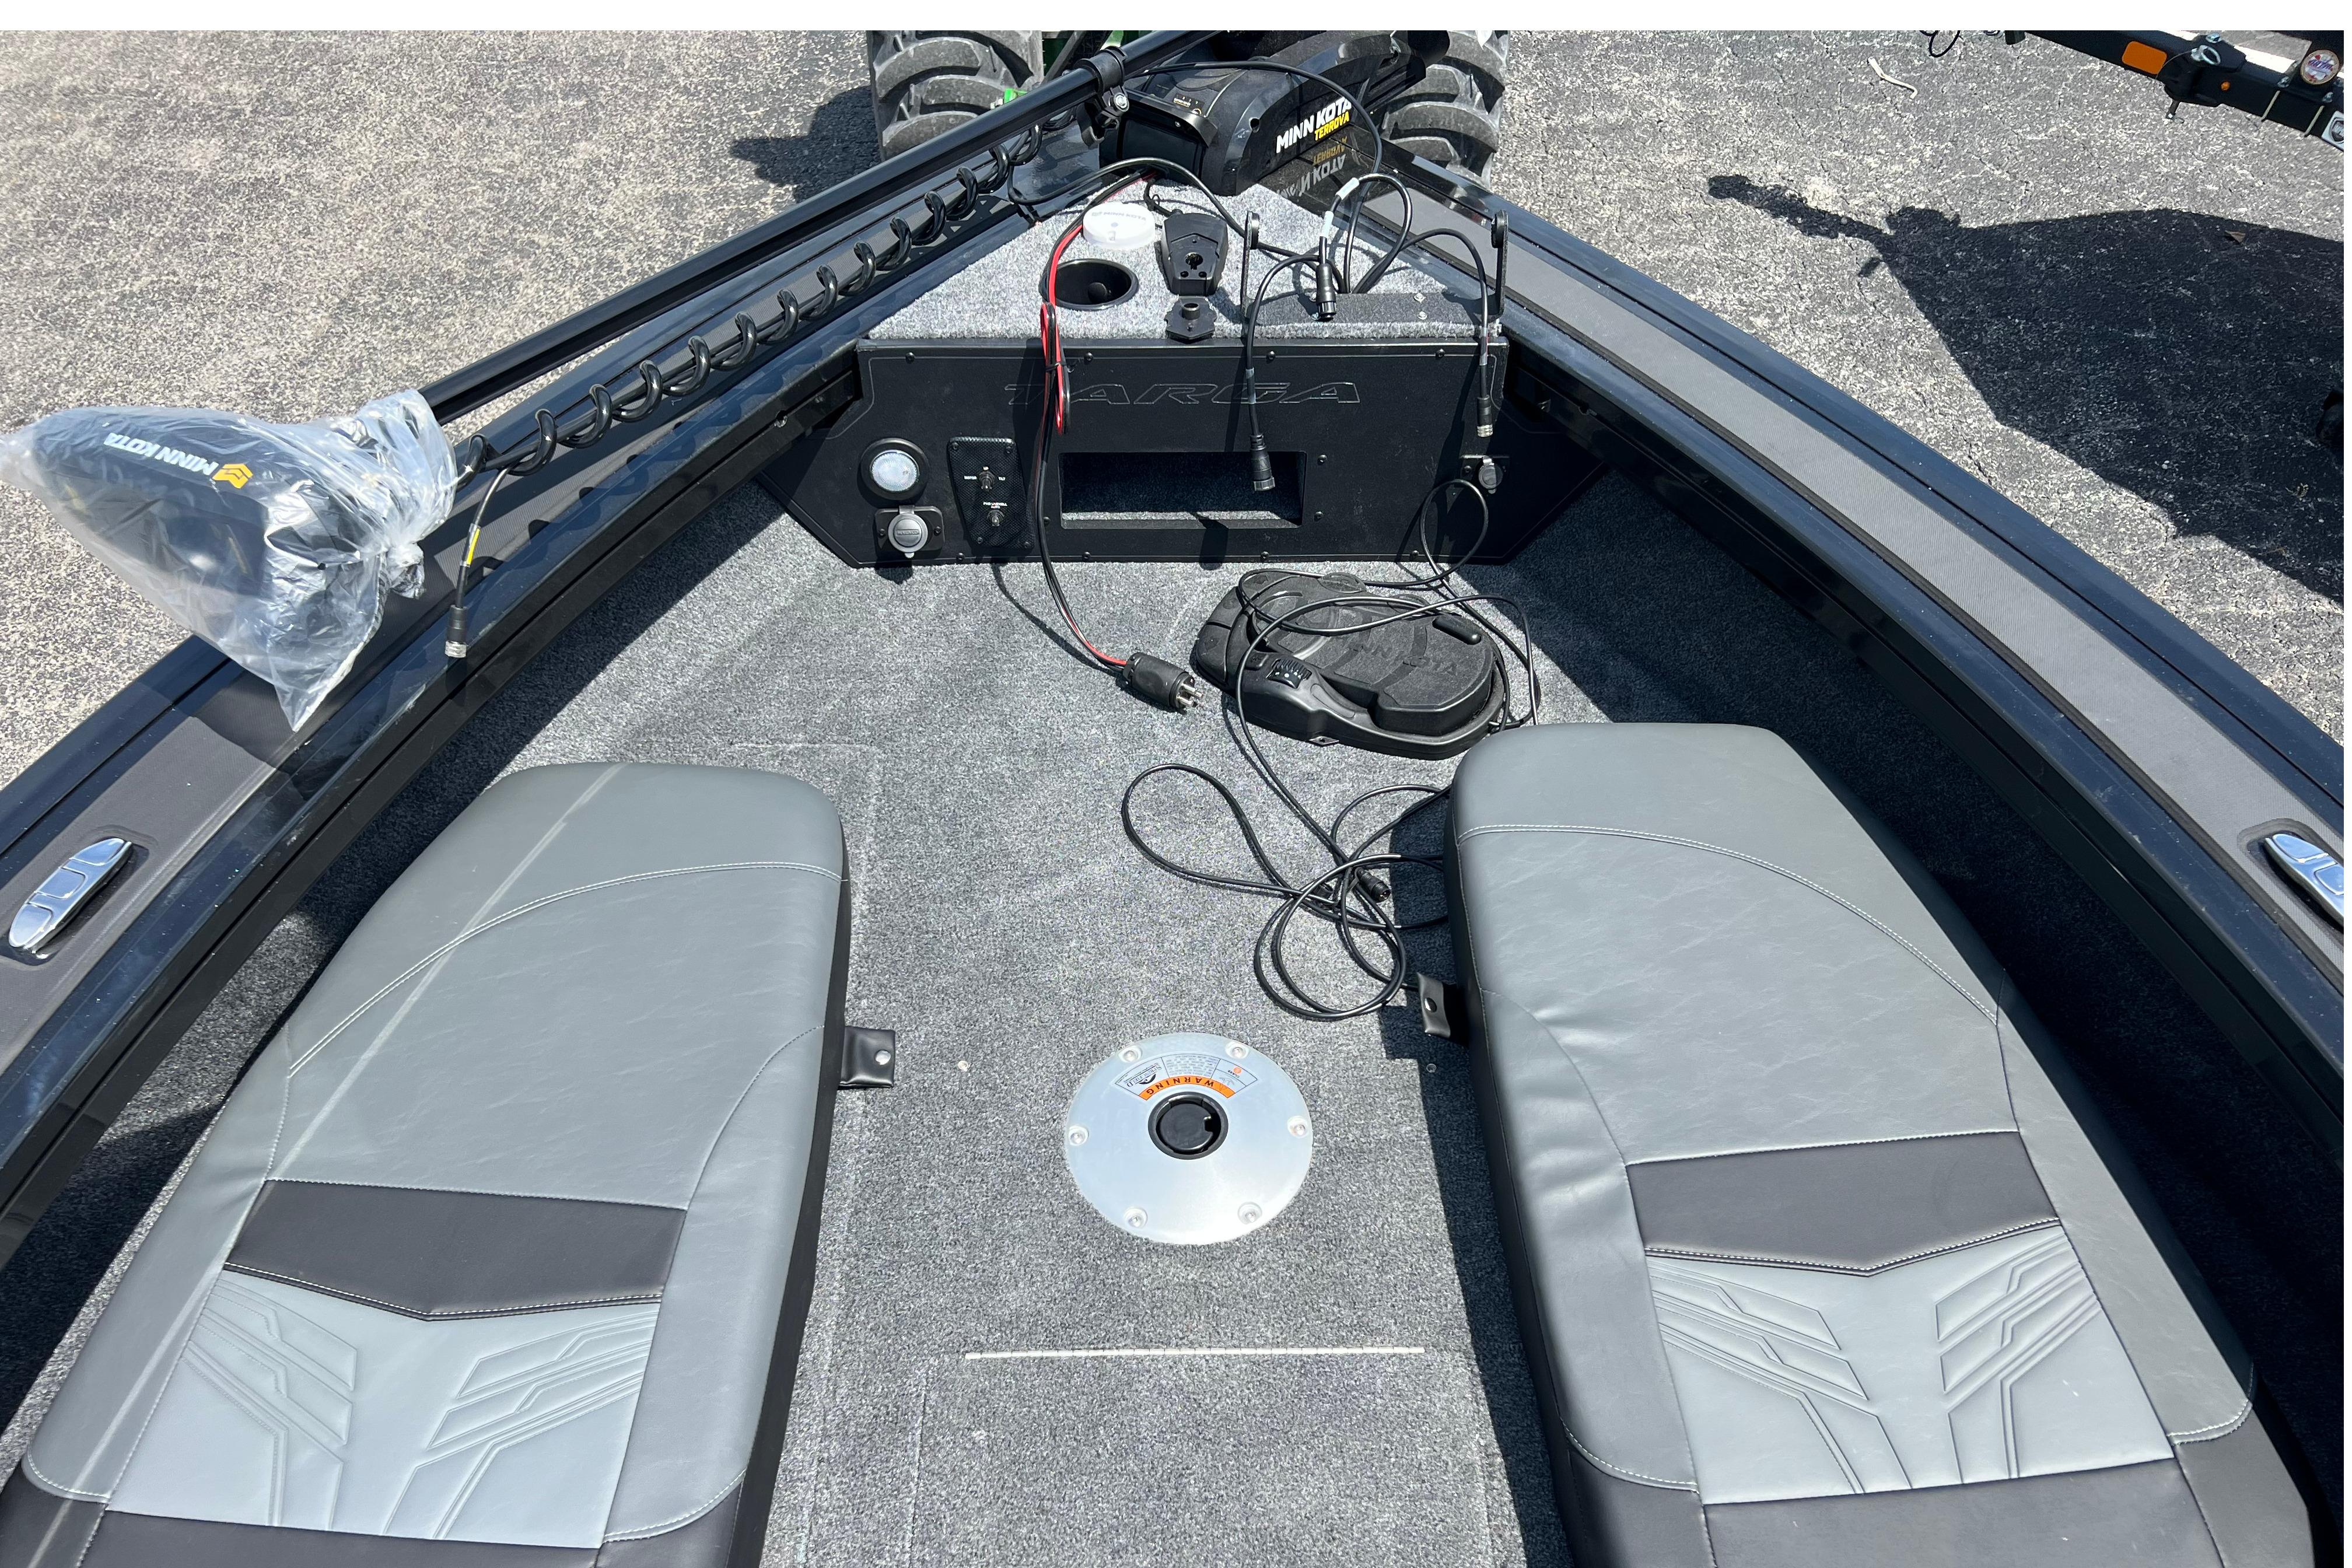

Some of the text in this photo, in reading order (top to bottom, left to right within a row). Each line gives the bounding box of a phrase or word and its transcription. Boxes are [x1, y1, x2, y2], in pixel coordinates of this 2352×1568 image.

[1276, 97, 1352, 153] MINN KOTA
[1314, 111, 1350, 141] TERROVA
[1005, 383, 1360, 404] TARGA
[104, 432, 219, 475] MINN KOTA
[1146, 1077, 1214, 1095] WARNING
